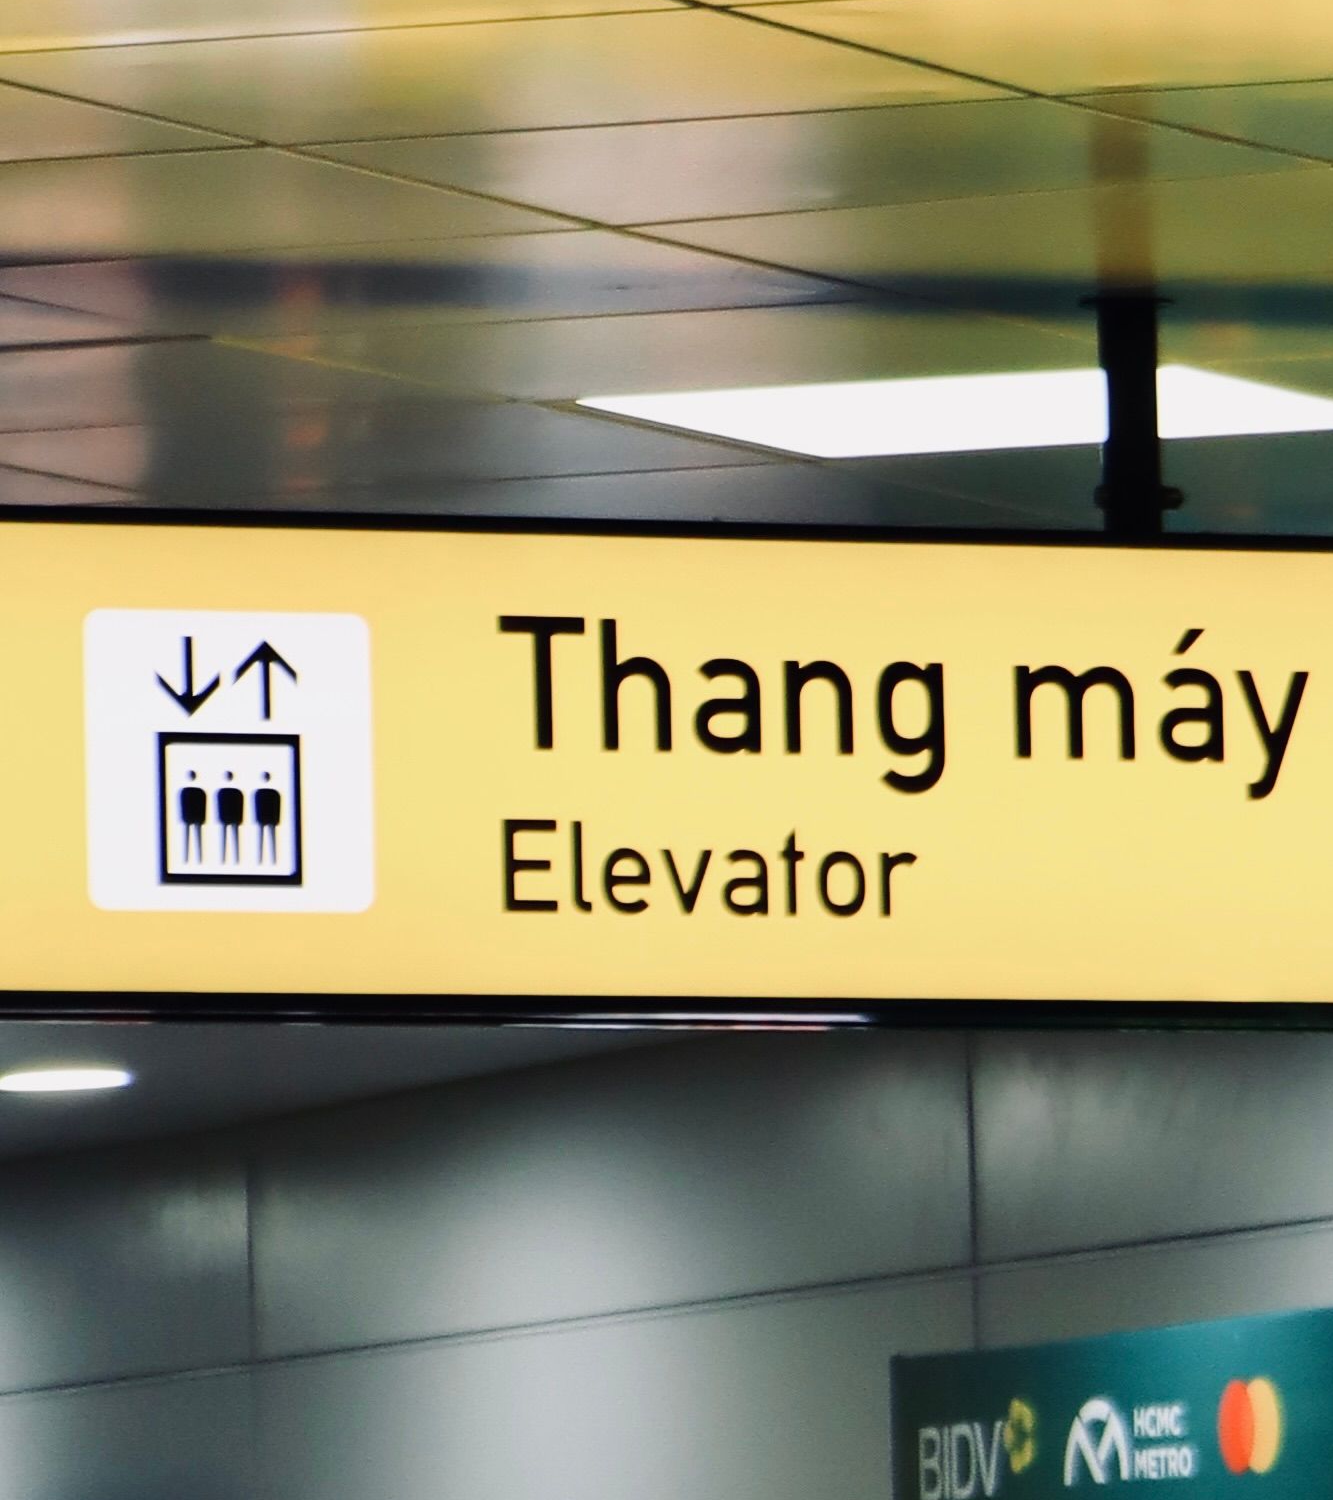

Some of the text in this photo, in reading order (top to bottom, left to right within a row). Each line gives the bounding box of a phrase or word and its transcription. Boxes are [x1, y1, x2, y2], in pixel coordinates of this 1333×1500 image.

[499, 613, 1309, 799] Thang máy
[502, 818, 918, 918] Elevator
[1132, 1401, 1186, 1438] HCMC
[1133, 1446, 1193, 1480] METRO
